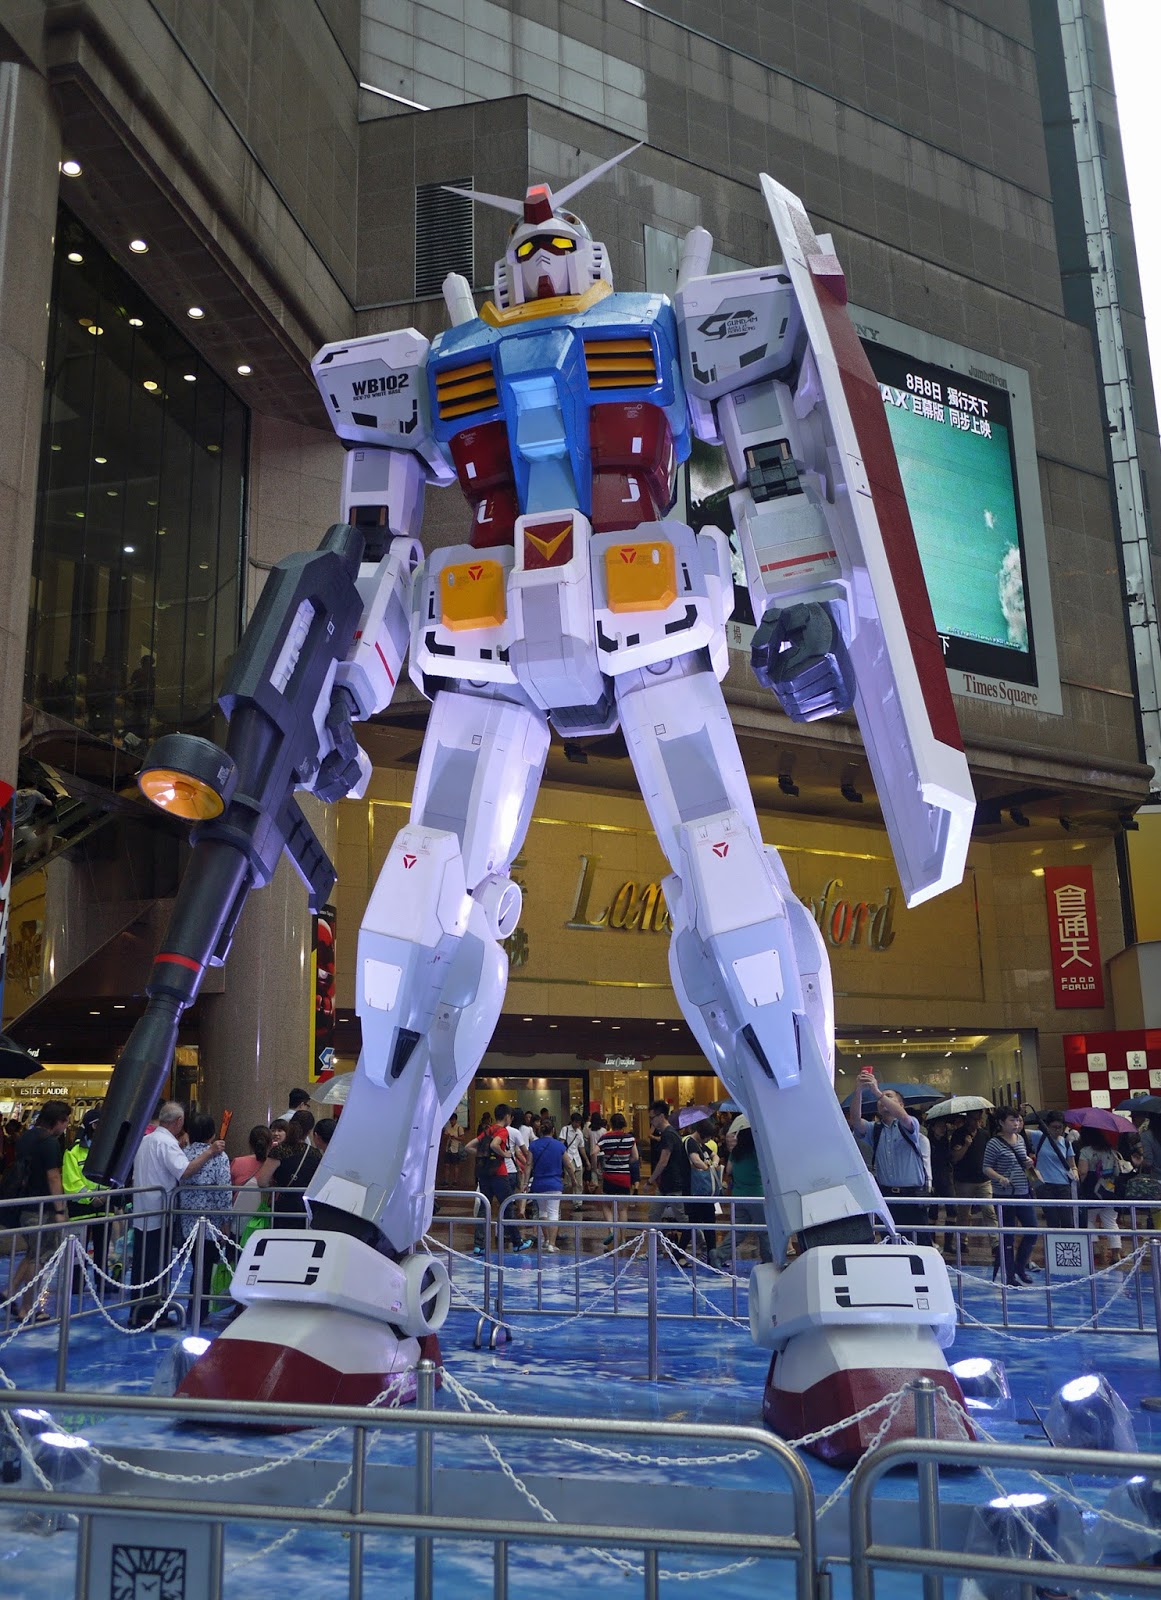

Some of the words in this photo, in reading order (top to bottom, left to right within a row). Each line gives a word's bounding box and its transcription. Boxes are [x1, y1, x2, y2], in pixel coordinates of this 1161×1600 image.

[352, 373, 409, 396] WB102
[906, 373, 942, 401] 8月8日
[912, 395, 945, 424] 巨幕版
[949, 407, 993, 440] 同步上映
[963, 674, 998, 699] Times
[1000, 681, 1039, 707] Square
[1061, 976, 1095, 984] FOOD
[1061, 983, 1096, 991] FORUM
[42, 1087, 69, 1095] LAUDER
